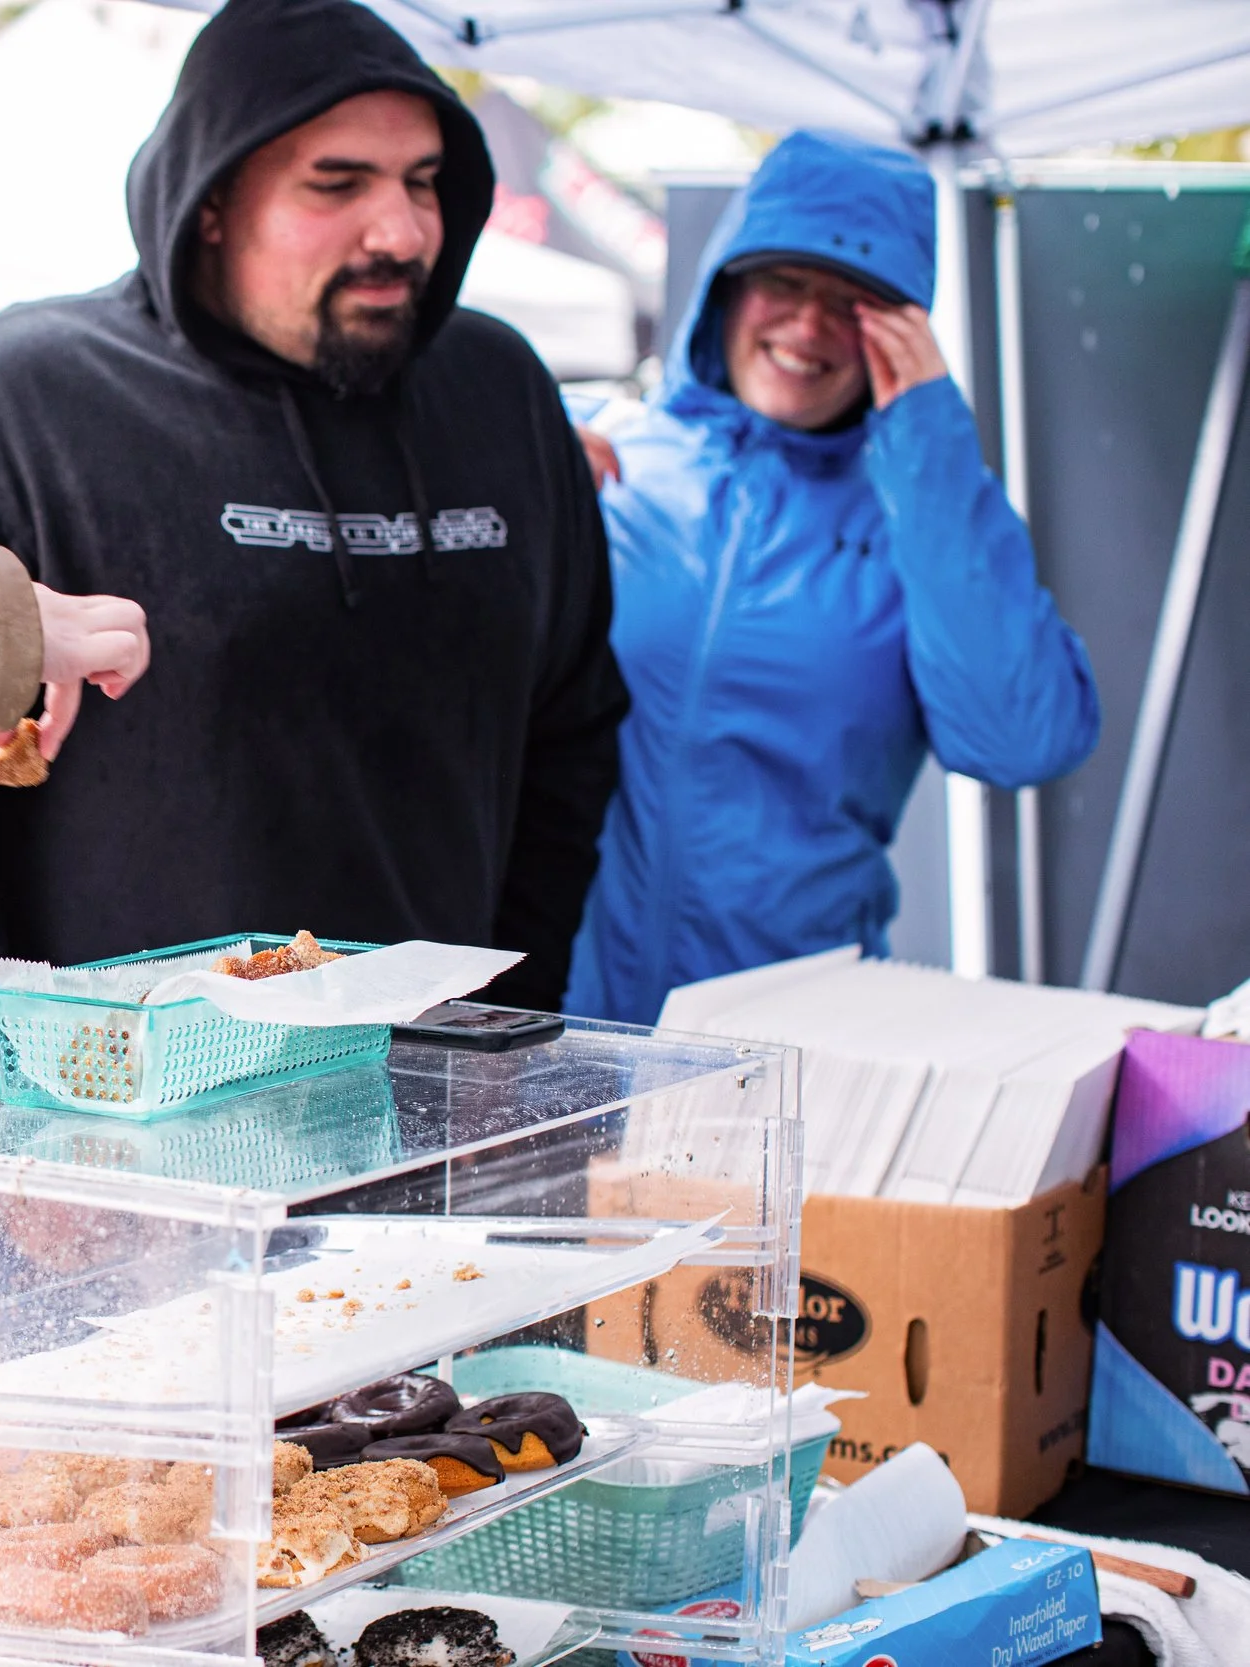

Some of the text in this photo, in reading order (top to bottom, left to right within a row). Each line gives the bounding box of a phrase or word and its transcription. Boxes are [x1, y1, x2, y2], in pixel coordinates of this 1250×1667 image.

[1046, 1562, 1083, 1590] EZ-10
[1009, 1591, 1066, 1637] Interfolded
[992, 1646, 1013, 1667] Dry
[1015, 1622, 1054, 1657] Waxed
[1056, 1614, 1088, 1641] Paper
